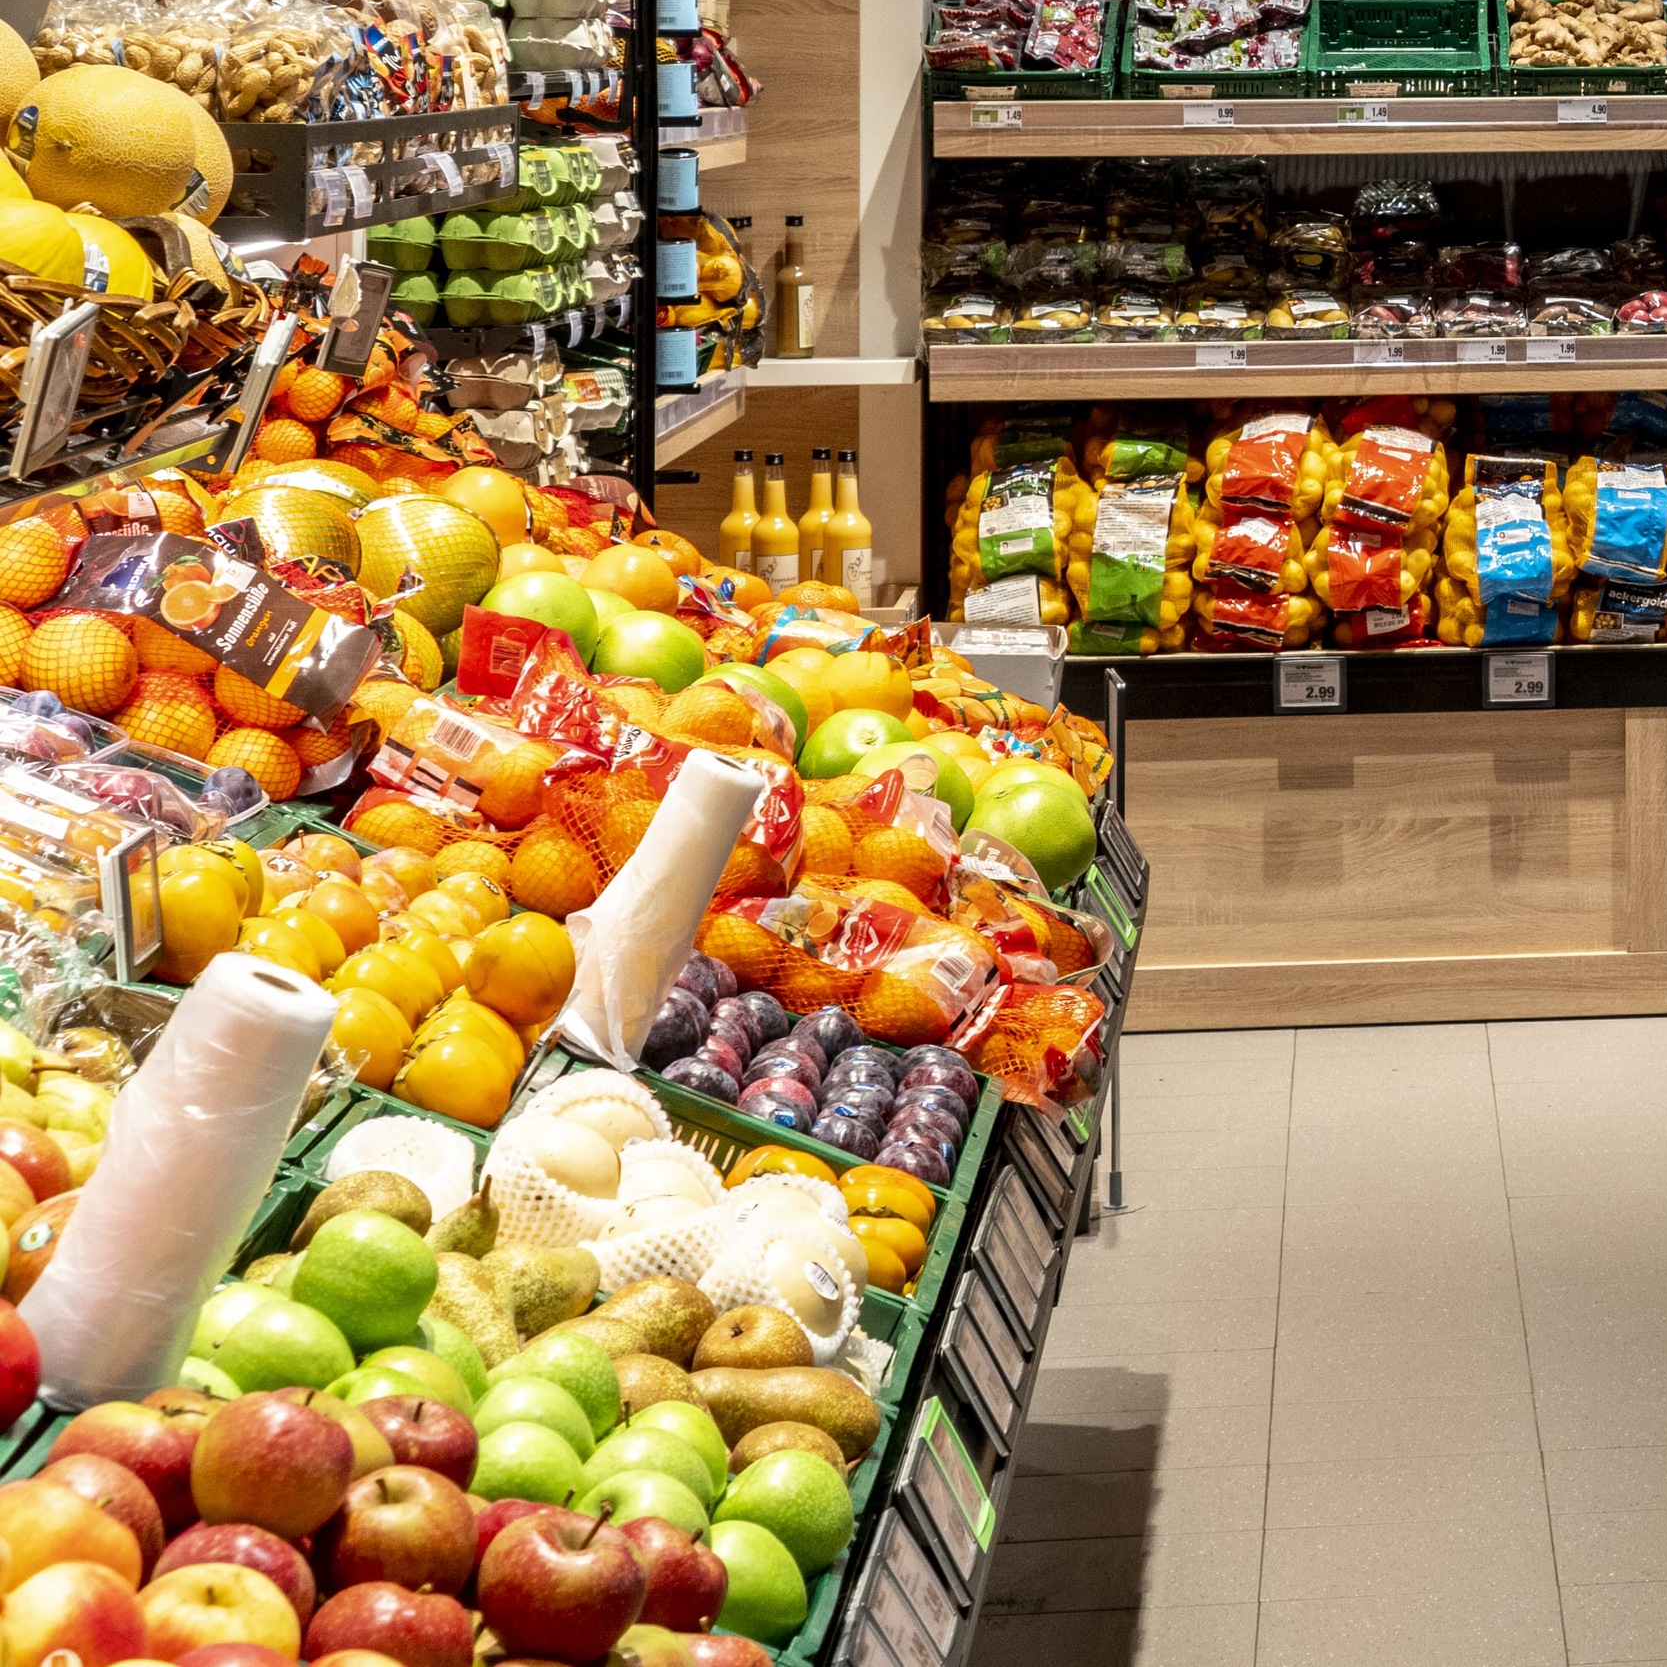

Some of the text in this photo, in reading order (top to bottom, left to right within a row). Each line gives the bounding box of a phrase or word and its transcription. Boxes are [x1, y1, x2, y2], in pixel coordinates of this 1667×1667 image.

[1218, 108, 1233, 118] 0.99
[1372, 107, 1387, 117] 1.49
[1591, 104, 1606, 114] 4.90
[1006, 111, 1021, 120] 1.49
[1387, 347, 1402, 358] 1.99
[1490, 345, 1505, 356] 1.99
[1560, 343, 1575, 354] 1.99
[1230, 350, 1245, 361] 1.99
[215, 581, 270, 654] Sonnensüße
[245, 610, 273, 649] Orangen
[1305, 686, 1336, 699] 2.99
[1514, 681, 1544, 694] 2.99
